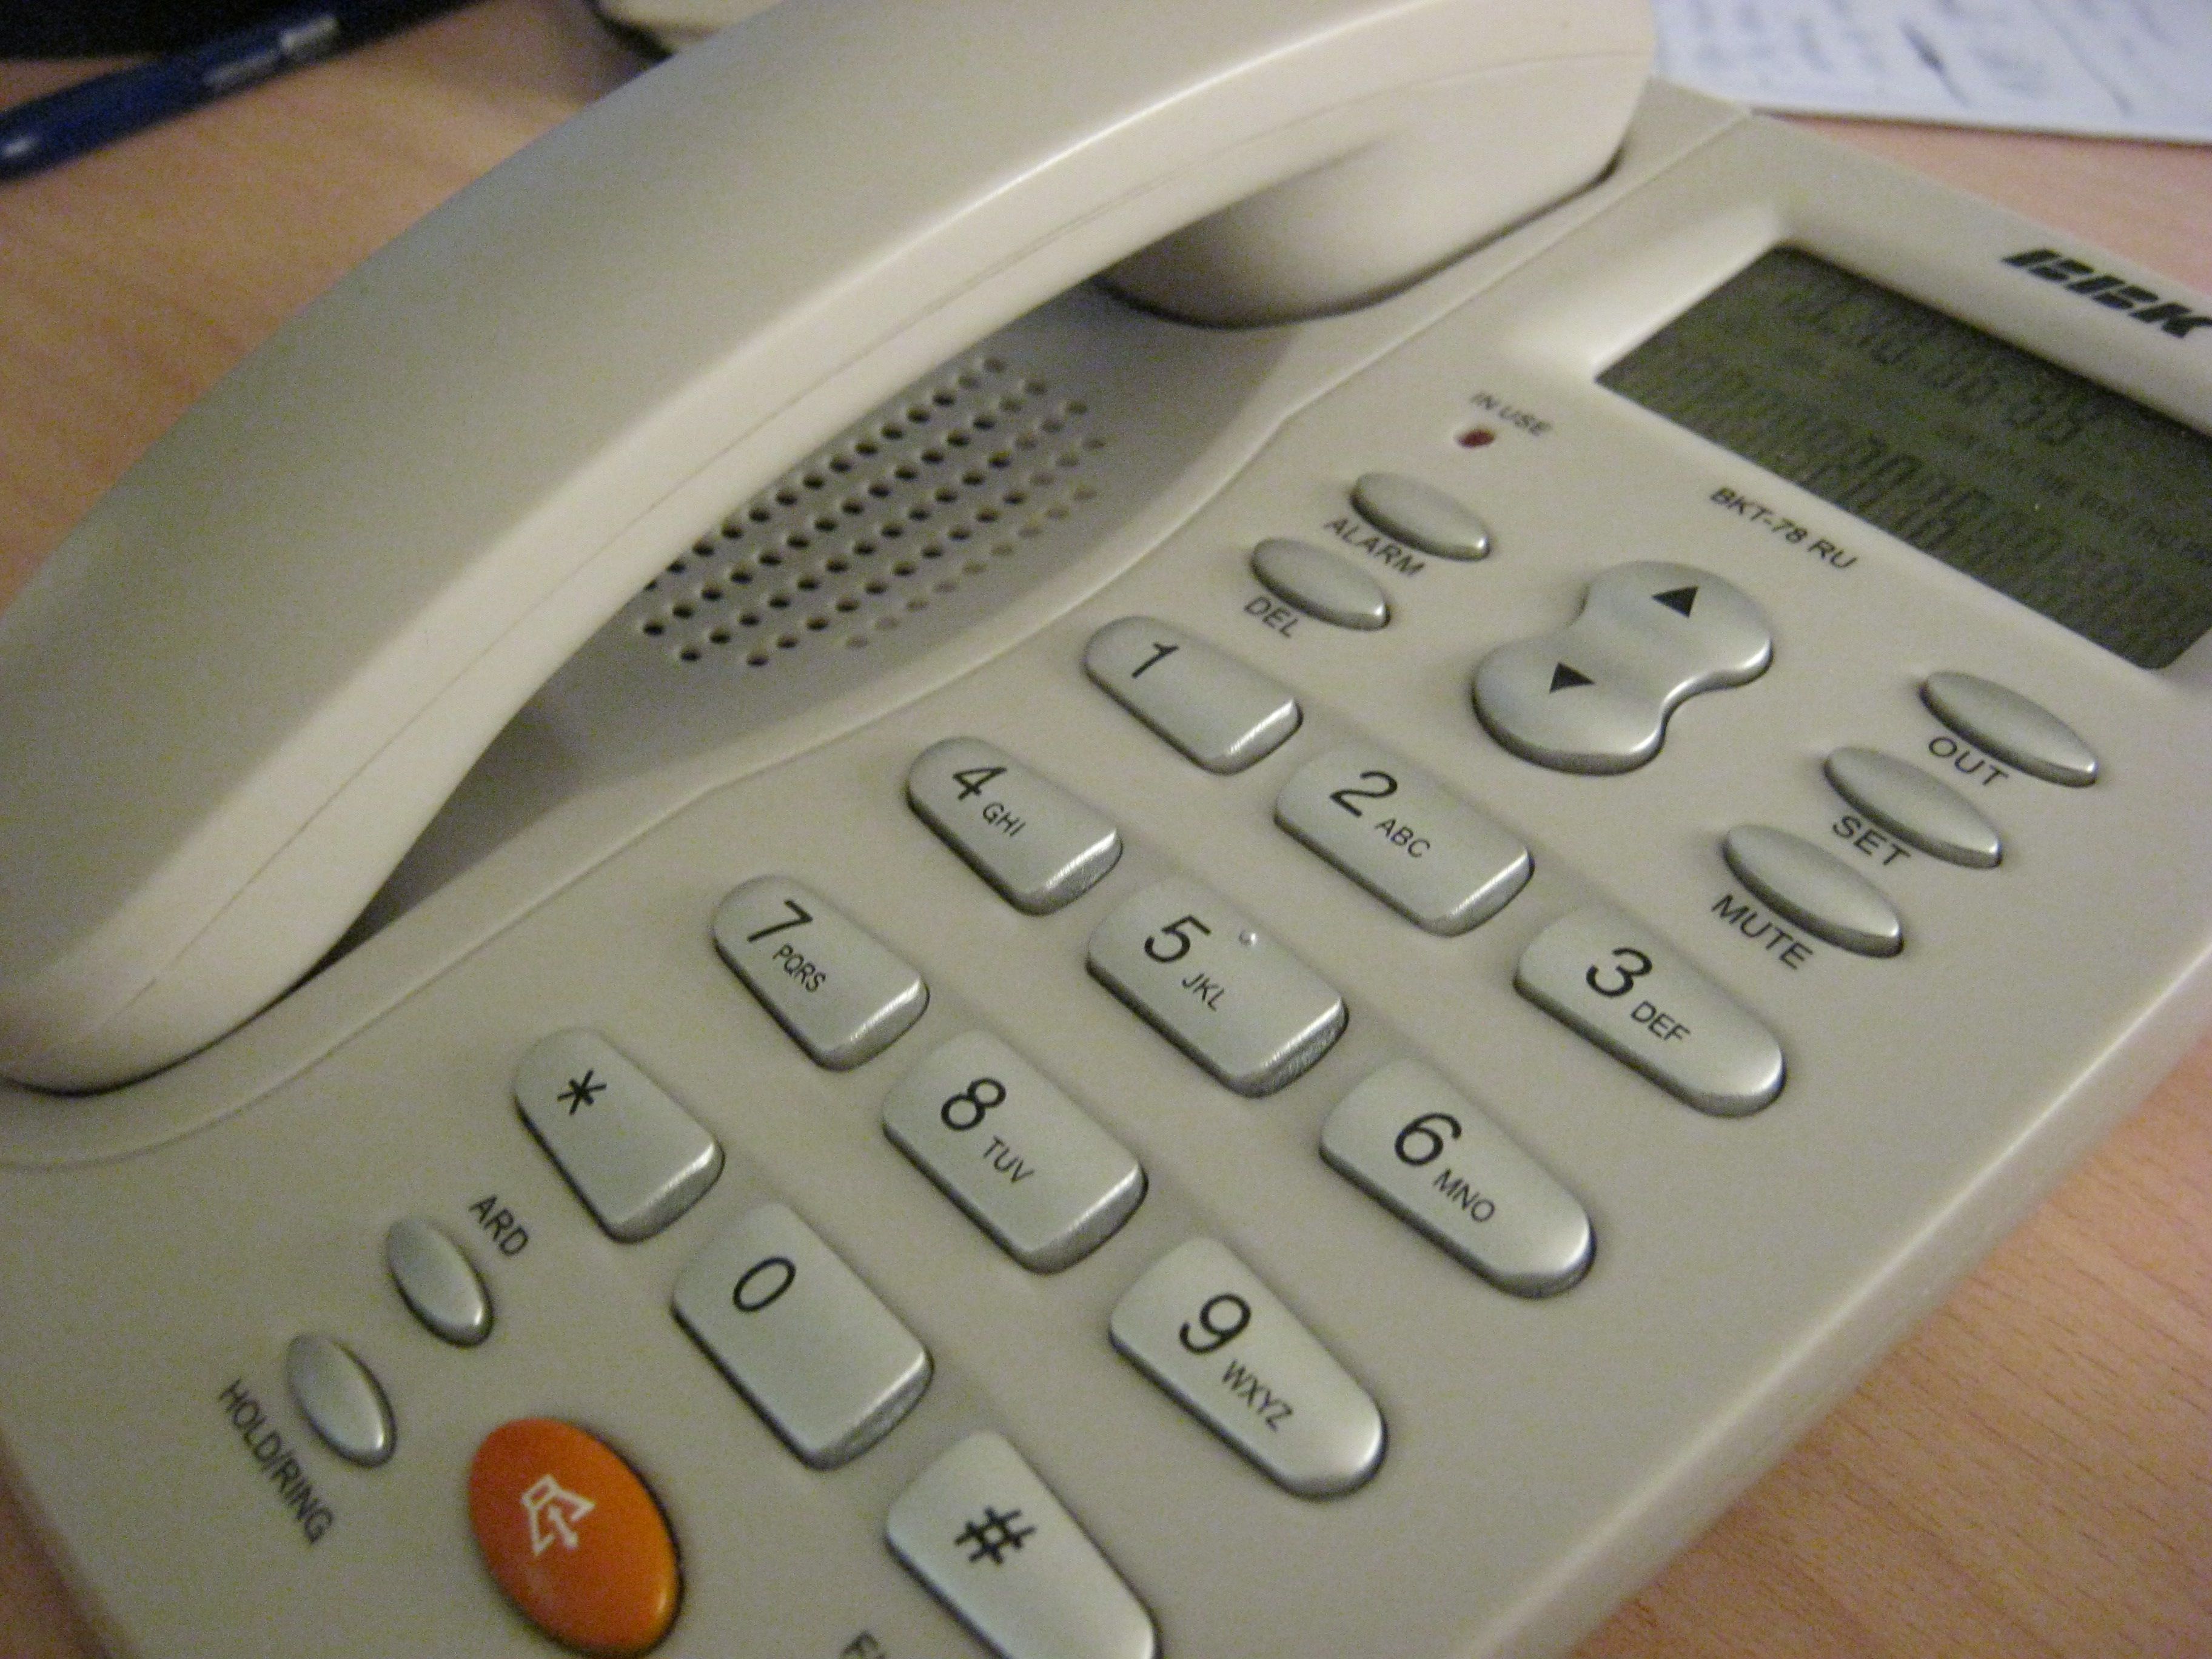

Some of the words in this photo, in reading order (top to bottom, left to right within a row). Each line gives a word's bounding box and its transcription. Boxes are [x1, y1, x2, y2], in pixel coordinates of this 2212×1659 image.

[1324, 517, 1426, 576] ALARM
[1709, 486, 1809, 545] BKT-78
[1808, 536, 1858, 569] RU
[1244, 596, 1299, 639] DEL
[1132, 643, 1178, 678] 1
[1929, 736, 2010, 786] OUT
[953, 766, 1007, 800] 4
[982, 802, 1026, 837] GHI
[1330, 771, 1398, 817] 2
[1376, 819, 1430, 857] ABC
[1833, 814, 1912, 866] SET
[748, 898, 814, 942] 7
[1712, 894, 1814, 970] MUTE
[773, 945, 825, 991] PQRS
[1144, 916, 1210, 963] 5
[1181, 973, 1225, 1011] JKL
[1586, 948, 1652, 997] 3
[1631, 1001, 1689, 1040] DEF
[941, 1078, 1005, 1131] 8
[984, 1136, 1034, 1184] TUV
[1395, 1113, 1461, 1166] 6
[1435, 1169, 1495, 1222] MNO
[469, 1196, 529, 1256] ARD
[732, 1258, 796, 1313] 0
[1179, 1293, 1252, 1355] 9
[1222, 1358, 1294, 1430] WXYZ
[217, 1378, 334, 1544] HOLD/RING
